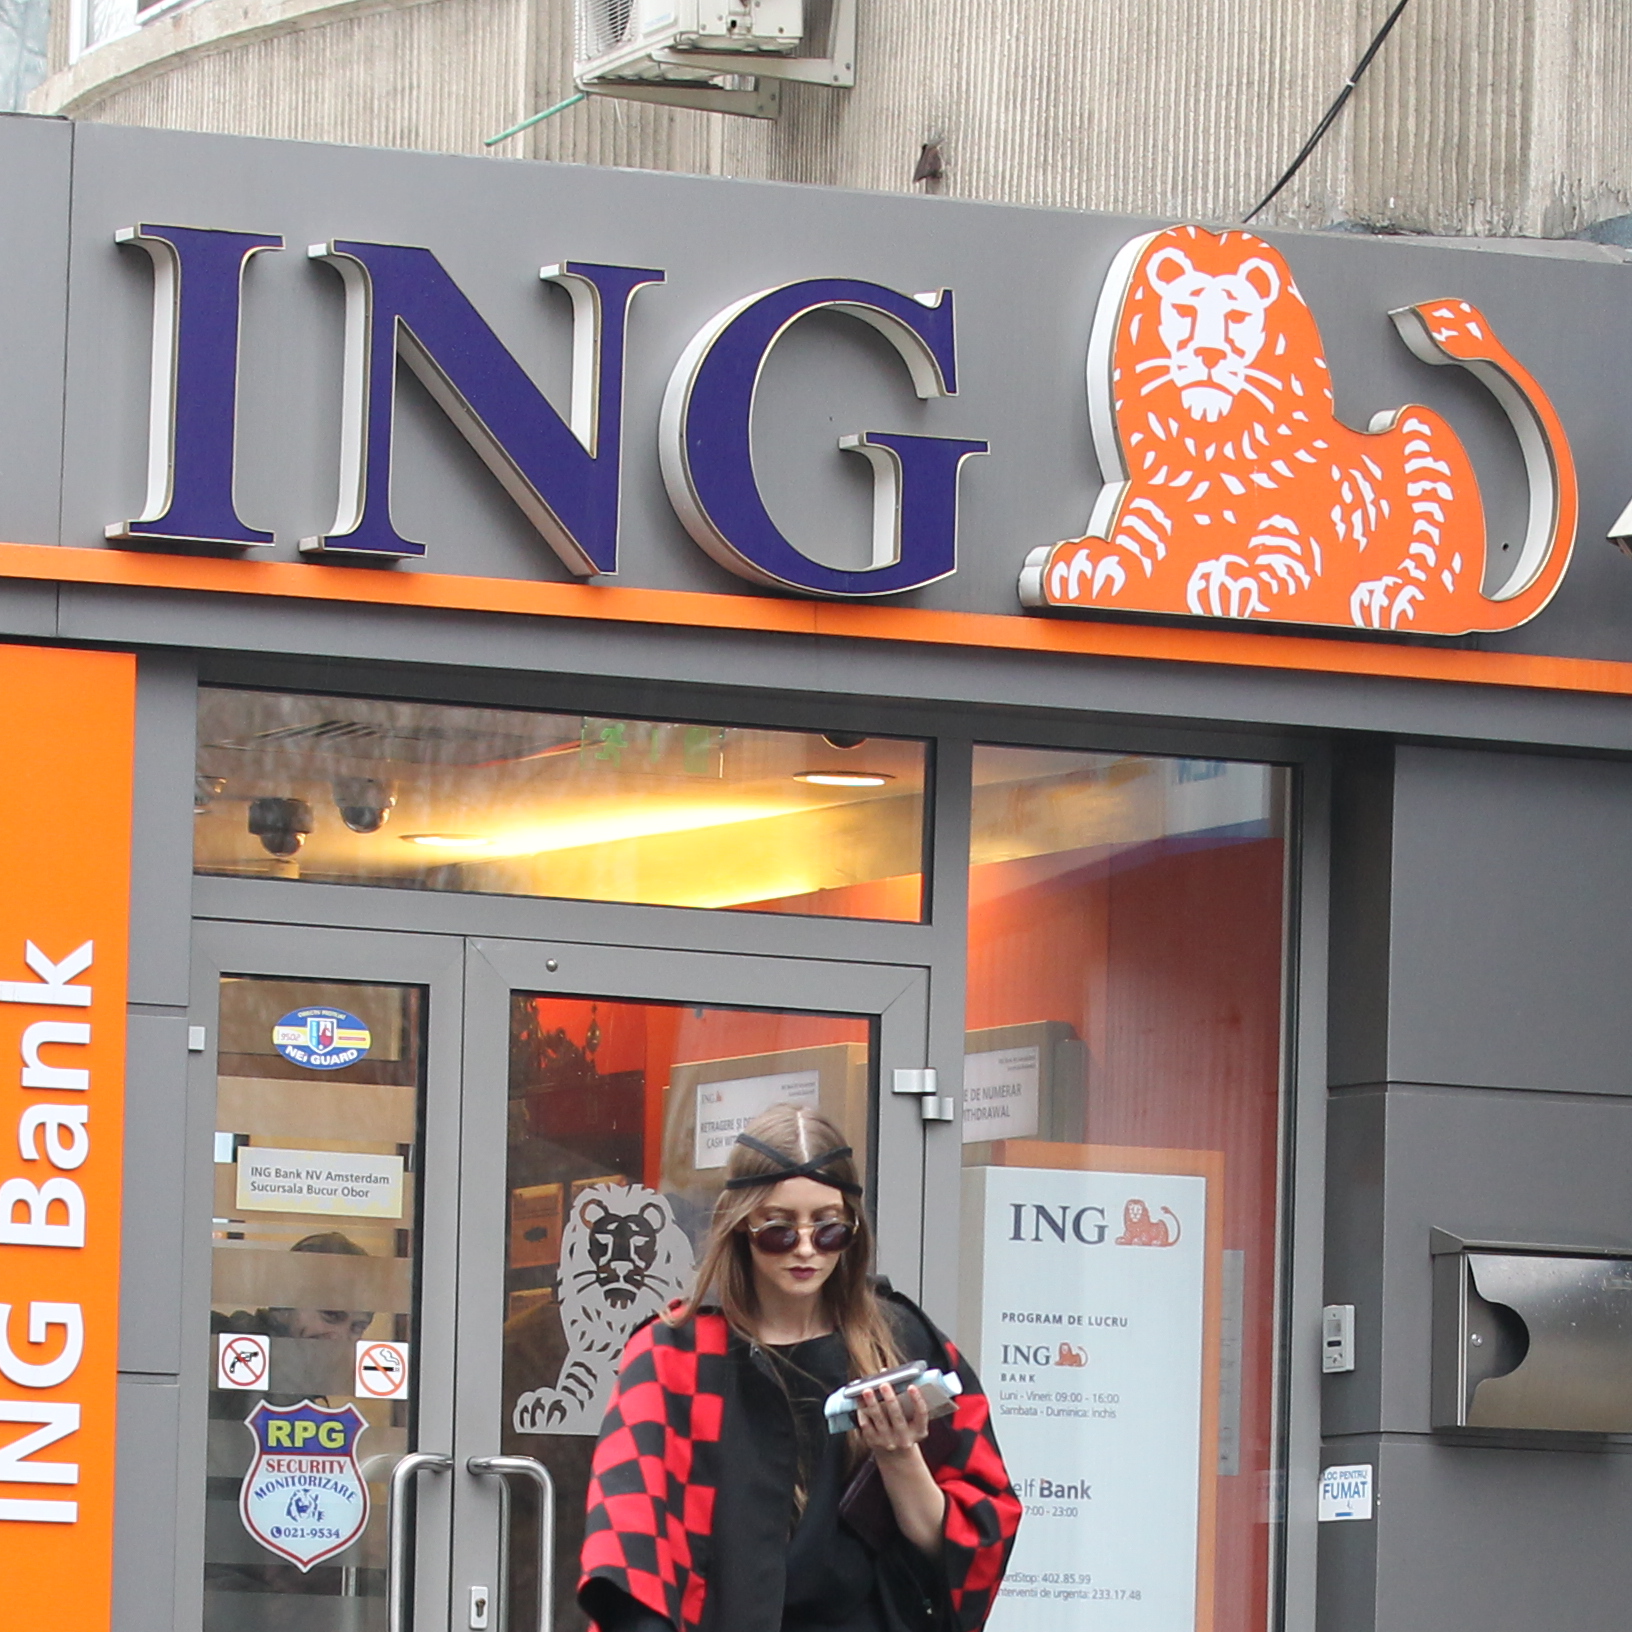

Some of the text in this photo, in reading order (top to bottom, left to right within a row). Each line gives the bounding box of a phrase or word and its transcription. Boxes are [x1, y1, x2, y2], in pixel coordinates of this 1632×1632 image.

[103, 223, 990, 598] ING
[310, 1048, 358, 1066] GUARD
[982, 1083, 1022, 1100] NUMERAR
[963, 1105, 1011, 1122] ITHDRAWAL
[250, 1166, 390, 1185] ING Bank NV Amsterdam
[250, 1181, 371, 1198] Sucursala Bucur Obor
[1008, 1202, 1109, 1245] ING
[1001, 1312, 1129, 1328] PROGRAM DE LUCRU
[1001, 1344, 1052, 1366] ING
[1000, 1372, 1036, 1383] BANK
[999, 1389, 1018, 1401] Luni
[1055, 1392, 1082, 1403] 09:00
[1092, 1393, 1120, 1404] 16:00
[999, 1404, 1038, 1416] Sambata
[267, 1420, 345, 1449] RPG
[265, 1458, 347, 1474] SECURITY
[1339, 1470, 1367, 1481] PENTRU
[254, 1475, 357, 1504] MONITORIZARE
[1013, 1478, 1092, 1499] elf Bank
[1322, 1481, 1368, 1500] FUMAT
[1052, 1506, 1078, 1517] 23:00
[283, 1527, 340, 1539] 021-9534
[1002, 1572, 1091, 1584] ardStop: 402.85.99
[997, 1587, 1142, 1601] nterventii de urgenta: 233.17.48
